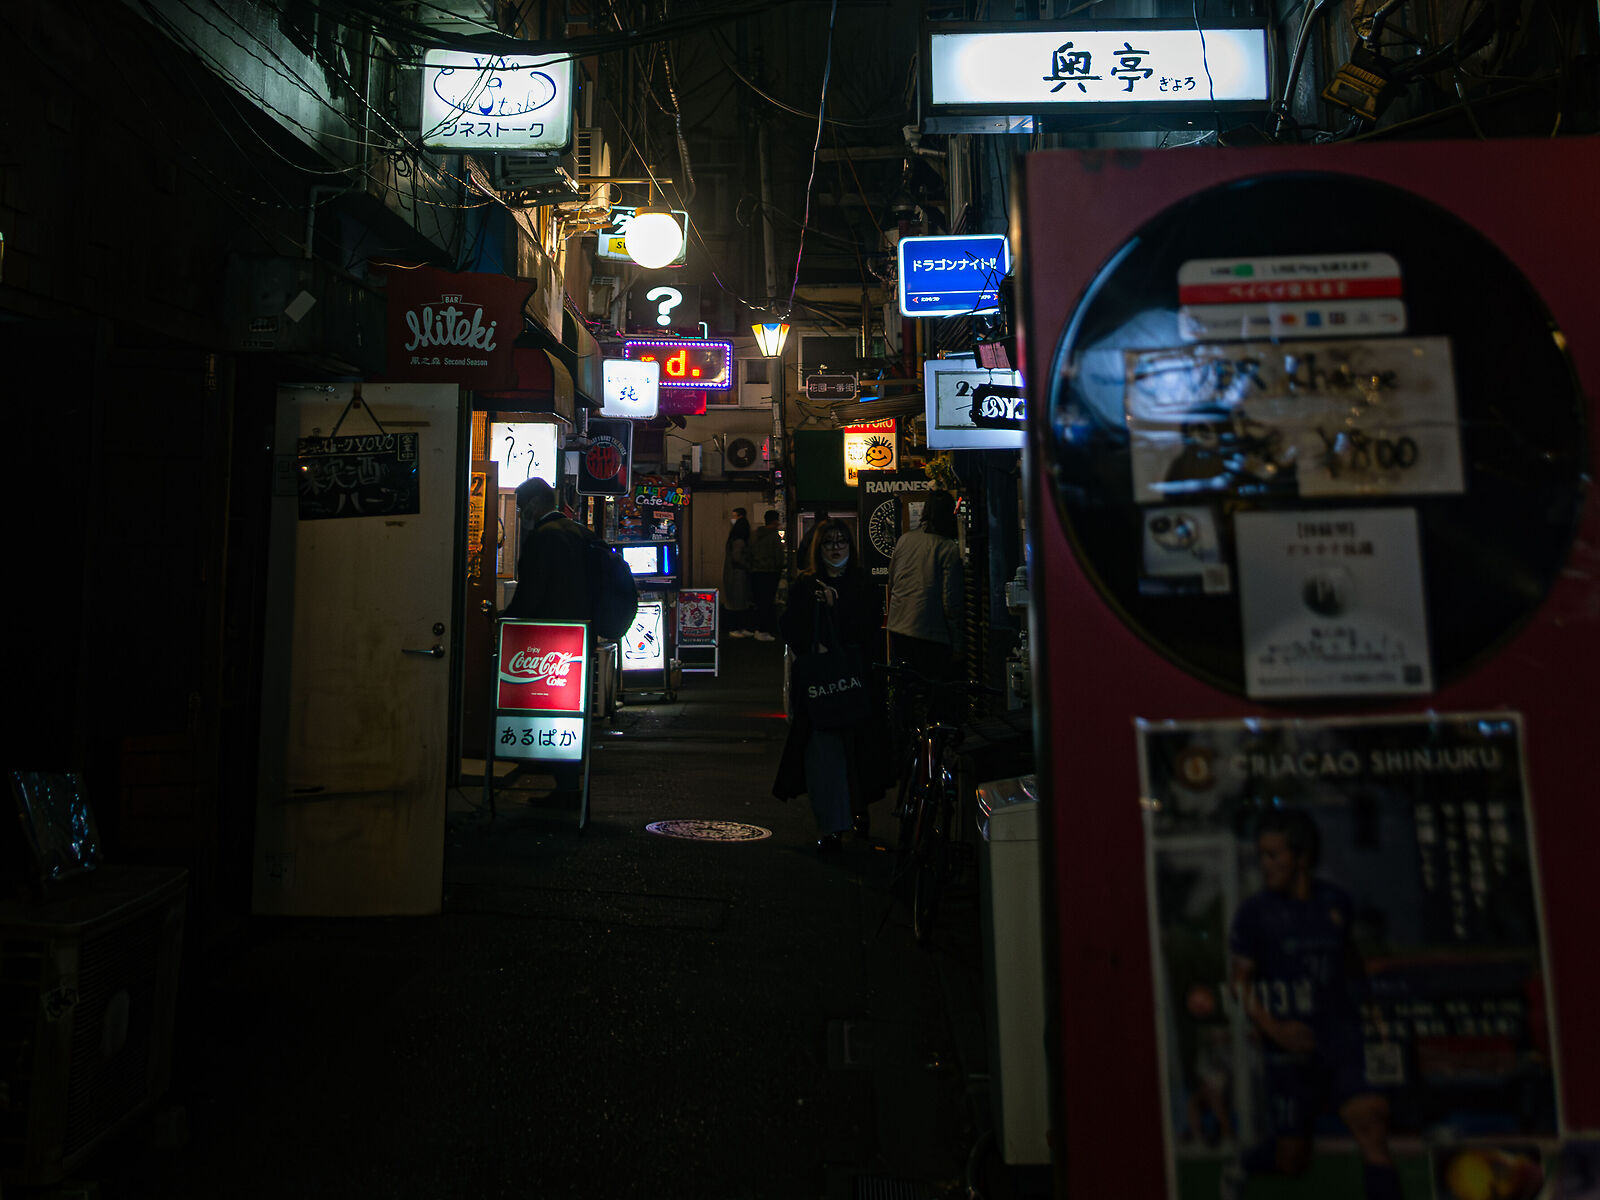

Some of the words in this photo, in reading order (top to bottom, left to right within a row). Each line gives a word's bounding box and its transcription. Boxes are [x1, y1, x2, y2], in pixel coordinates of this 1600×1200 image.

[1159, 76, 1196, 92] ぎょろ
[442, 121, 544, 138] シネストーク
[444, 356, 466, 366] Second
[466, 357, 488, 367] Season
[866, 481, 931, 493] RAMONES
[635, 495, 663, 505] Cafe
[546, 676, 568, 687] Coke
[500, 727, 577, 747] あるぱか
